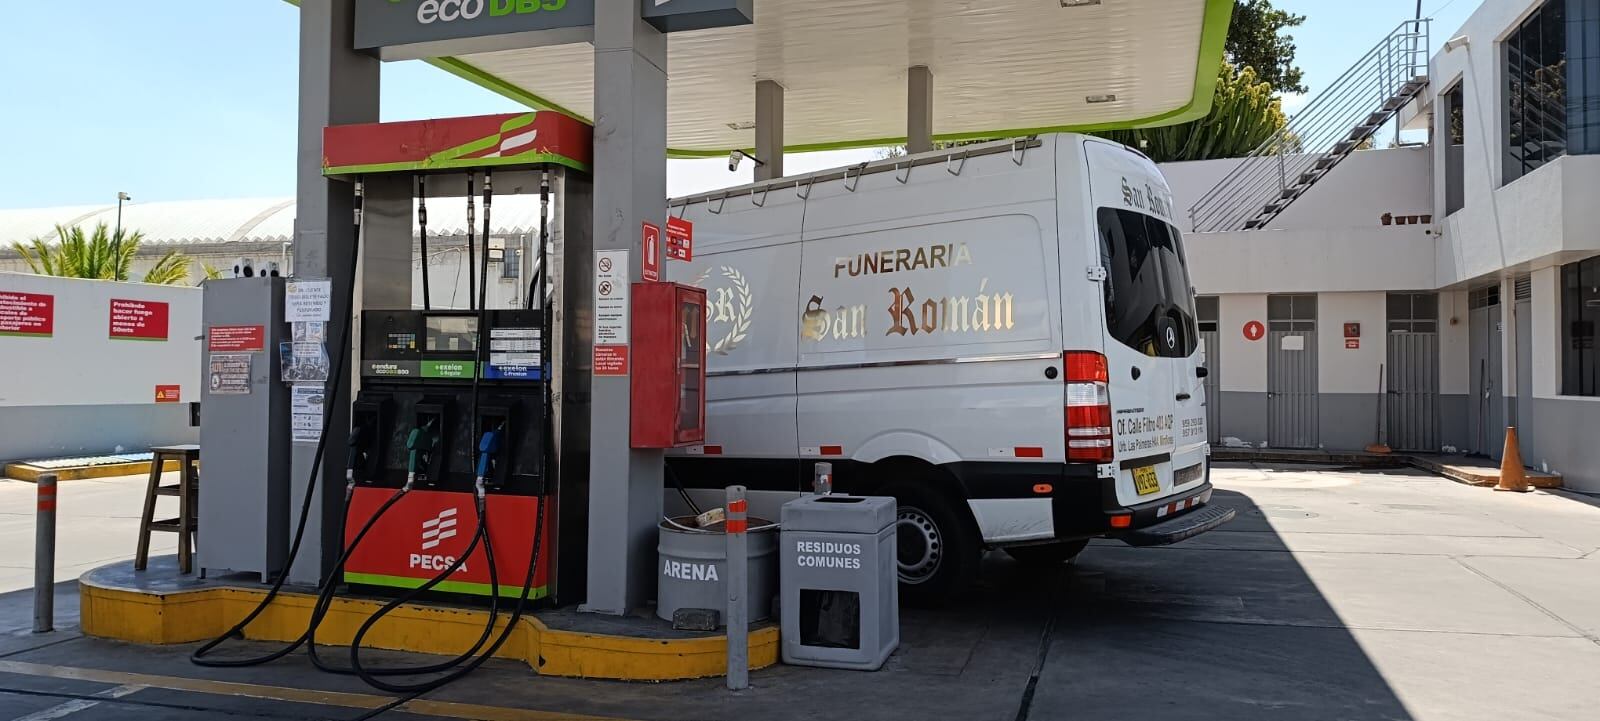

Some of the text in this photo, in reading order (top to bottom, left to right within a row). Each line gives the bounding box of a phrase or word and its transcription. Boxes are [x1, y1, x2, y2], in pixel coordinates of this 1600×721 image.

[417, 0, 483, 24] eco
[1121, 176, 1145, 209] San
[834, 242, 973, 278] FUNERARIA
[800, 277, 1015, 342] San Román
[1128, 417, 1142, 434] Calle
[797, 541, 861, 556] RESIDUOS
[663, 559, 720, 582] ARENA
[797, 555, 861, 570] COMUNES
